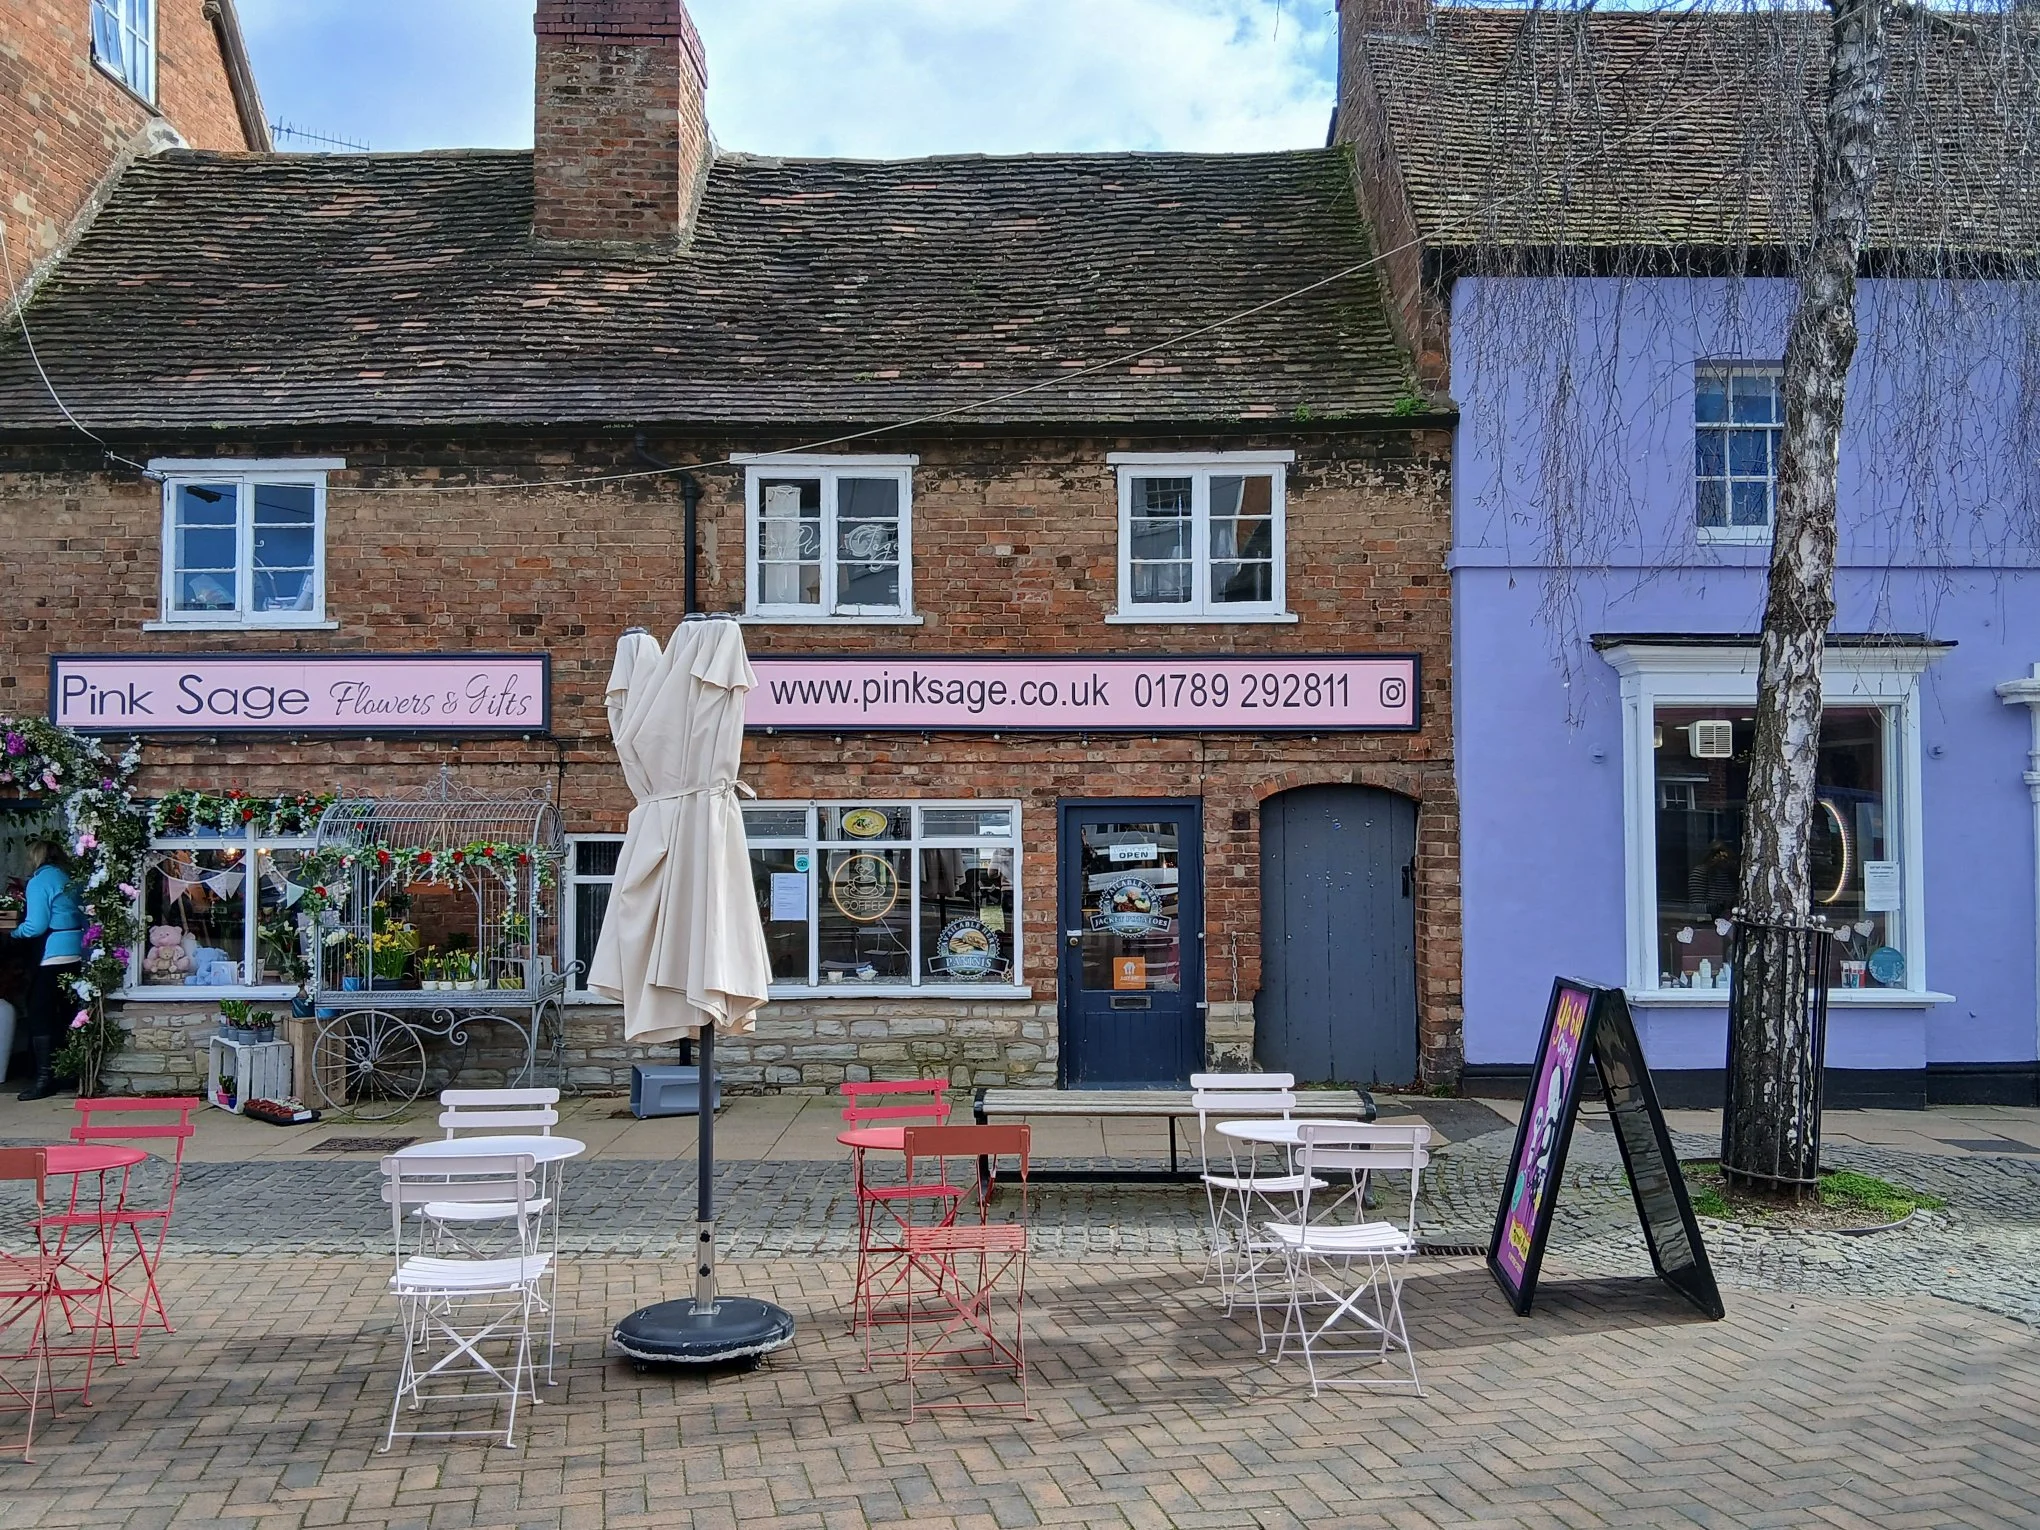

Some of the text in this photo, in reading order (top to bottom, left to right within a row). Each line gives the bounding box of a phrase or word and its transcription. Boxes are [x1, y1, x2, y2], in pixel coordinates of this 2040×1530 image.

[63, 674, 532, 719] Pink Sage Flowers & Gifts
[770, 671, 1349, 714] www.pinksage.co.uk 01789 292811
[1119, 851, 1149, 859] OPEN
[1103, 879, 1143, 906] AVAILABLE
[841, 900, 886, 911] COFFEE
[1094, 914, 1169, 928] JACKET POTATOES
[942, 920, 981, 948] AVAILABLE
[945, 957, 992, 968] PANINIS
